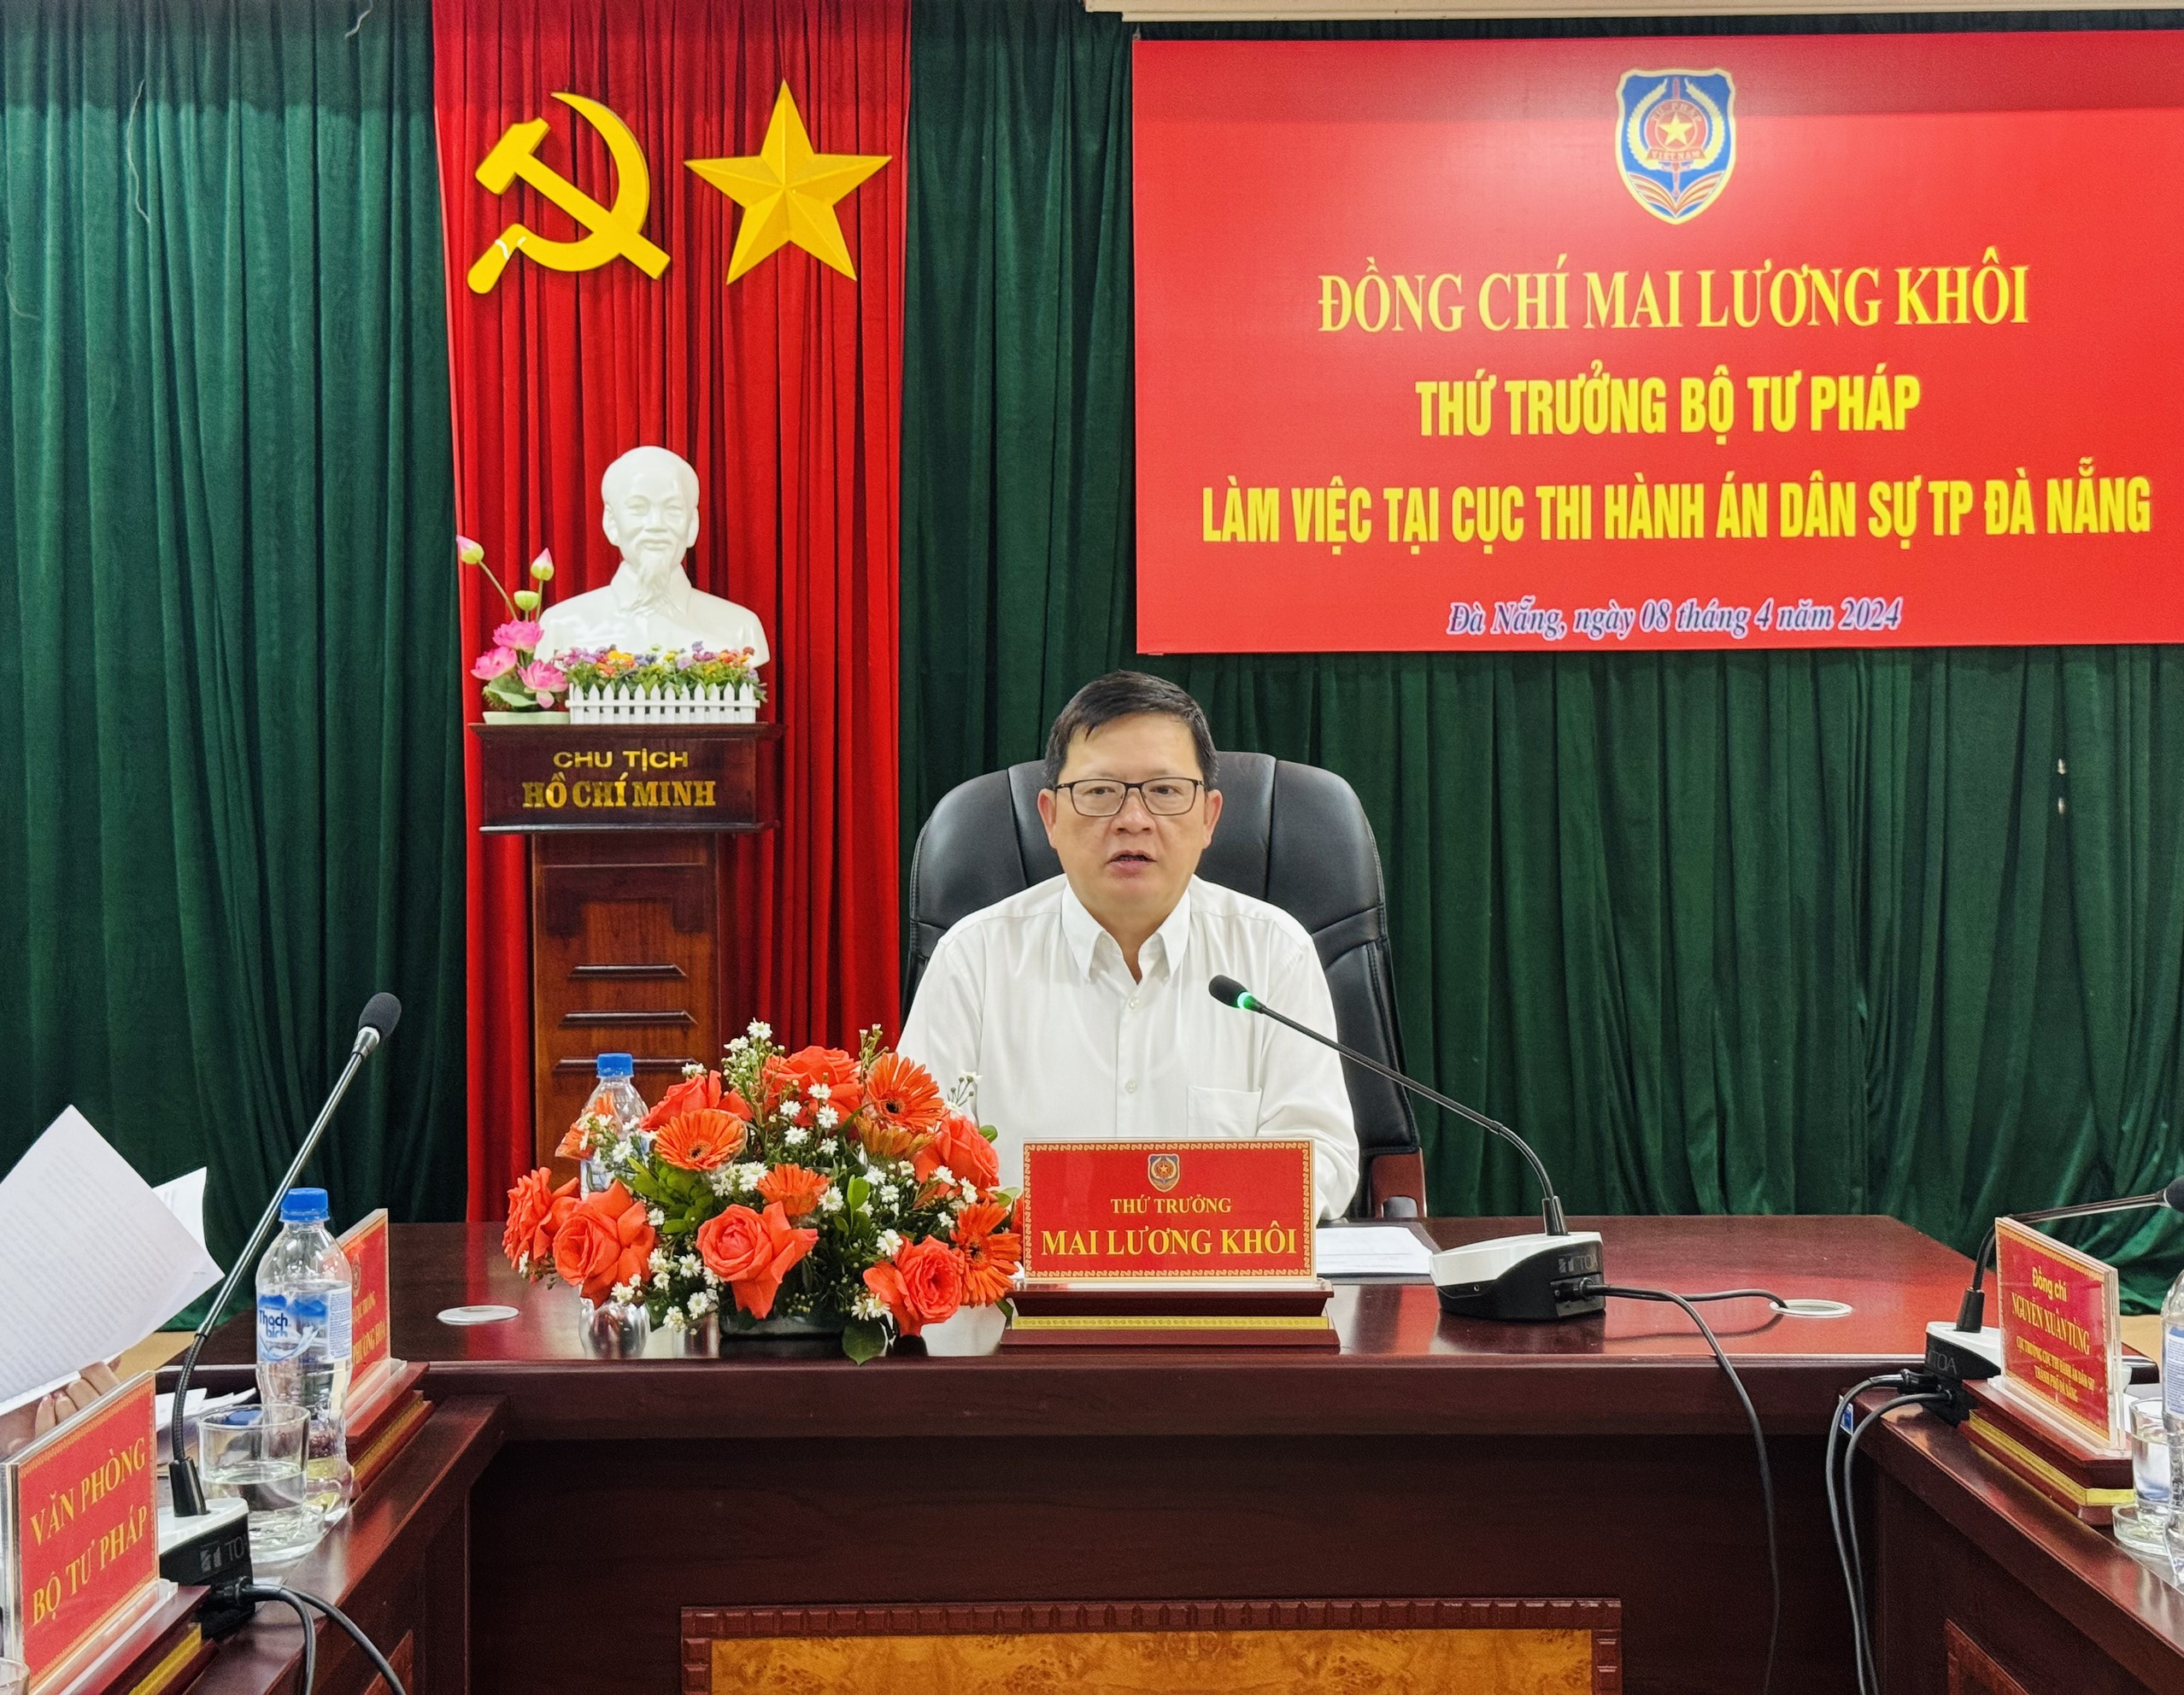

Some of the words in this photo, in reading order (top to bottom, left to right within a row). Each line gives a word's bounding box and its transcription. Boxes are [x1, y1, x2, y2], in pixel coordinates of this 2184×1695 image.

[1318, 256, 1465, 333] ĐỒNG
[1478, 253, 1570, 331] CHÍ
[1582, 269, 1684, 329] MAI
[1696, 258, 1882, 327] LƯƠNG
[1893, 245, 2029, 326] KHÔI
[1415, 368, 1497, 437] THỨ
[1504, 359, 1667, 436] TRƯỞNG
[1681, 364, 1735, 445] BỘ
[1747, 370, 1802, 432] TƯ
[1811, 362, 1921, 431] PHÁP
[1202, 475, 1279, 543] LÀM
[1290, 475, 1372, 555] VIỆC
[1383, 486, 1440, 554] TẠI
[1452, 485, 1524, 554] CỤC
[1535, 484, 1592, 540] THI
[1604, 472, 1705, 540] HÀNH
[1716, 471, 1768, 539] ÁN
[1780, 470, 1857, 538] DÂN
[1868, 475, 1922, 549] SỰ
[1928, 480, 1974, 537] TP
[1984, 466, 2036, 536] ĐÀ
[2046, 455, 2151, 535] NẴNG
[1446, 601, 1486, 635] Đà
[1490, 595, 1567, 641] Nẵng,
[1572, 599, 1635, 640] ngày
[1639, 598, 1673, 633] 08
[1675, 597, 1752, 639] tháng
[1753, 597, 1775, 631] 4
[1776, 599, 1835, 631] năm
[1837, 597, 1903, 630] 2024
[522, 771, 568, 808] HỒ
[572, 771, 629, 807] CHÍ
[631, 781, 716, 806] MINH
[622, 748, 689, 771] TỊCH
[1111, 1194, 1151, 1213] THỨ
[1041, 1229, 1099, 1256] MAI
[1106, 1225, 1213, 1255] LƯƠNG
[1219, 1220, 1297, 1253] KHÔI
[29, 1487, 75, 1547] VĂN
[80, 1437, 146, 1513] PHÒNG
[32, 1570, 62, 1627] BỘ
[65, 1539, 96, 1596] TƯ
[99, 1504, 148, 1572] PHÁP
